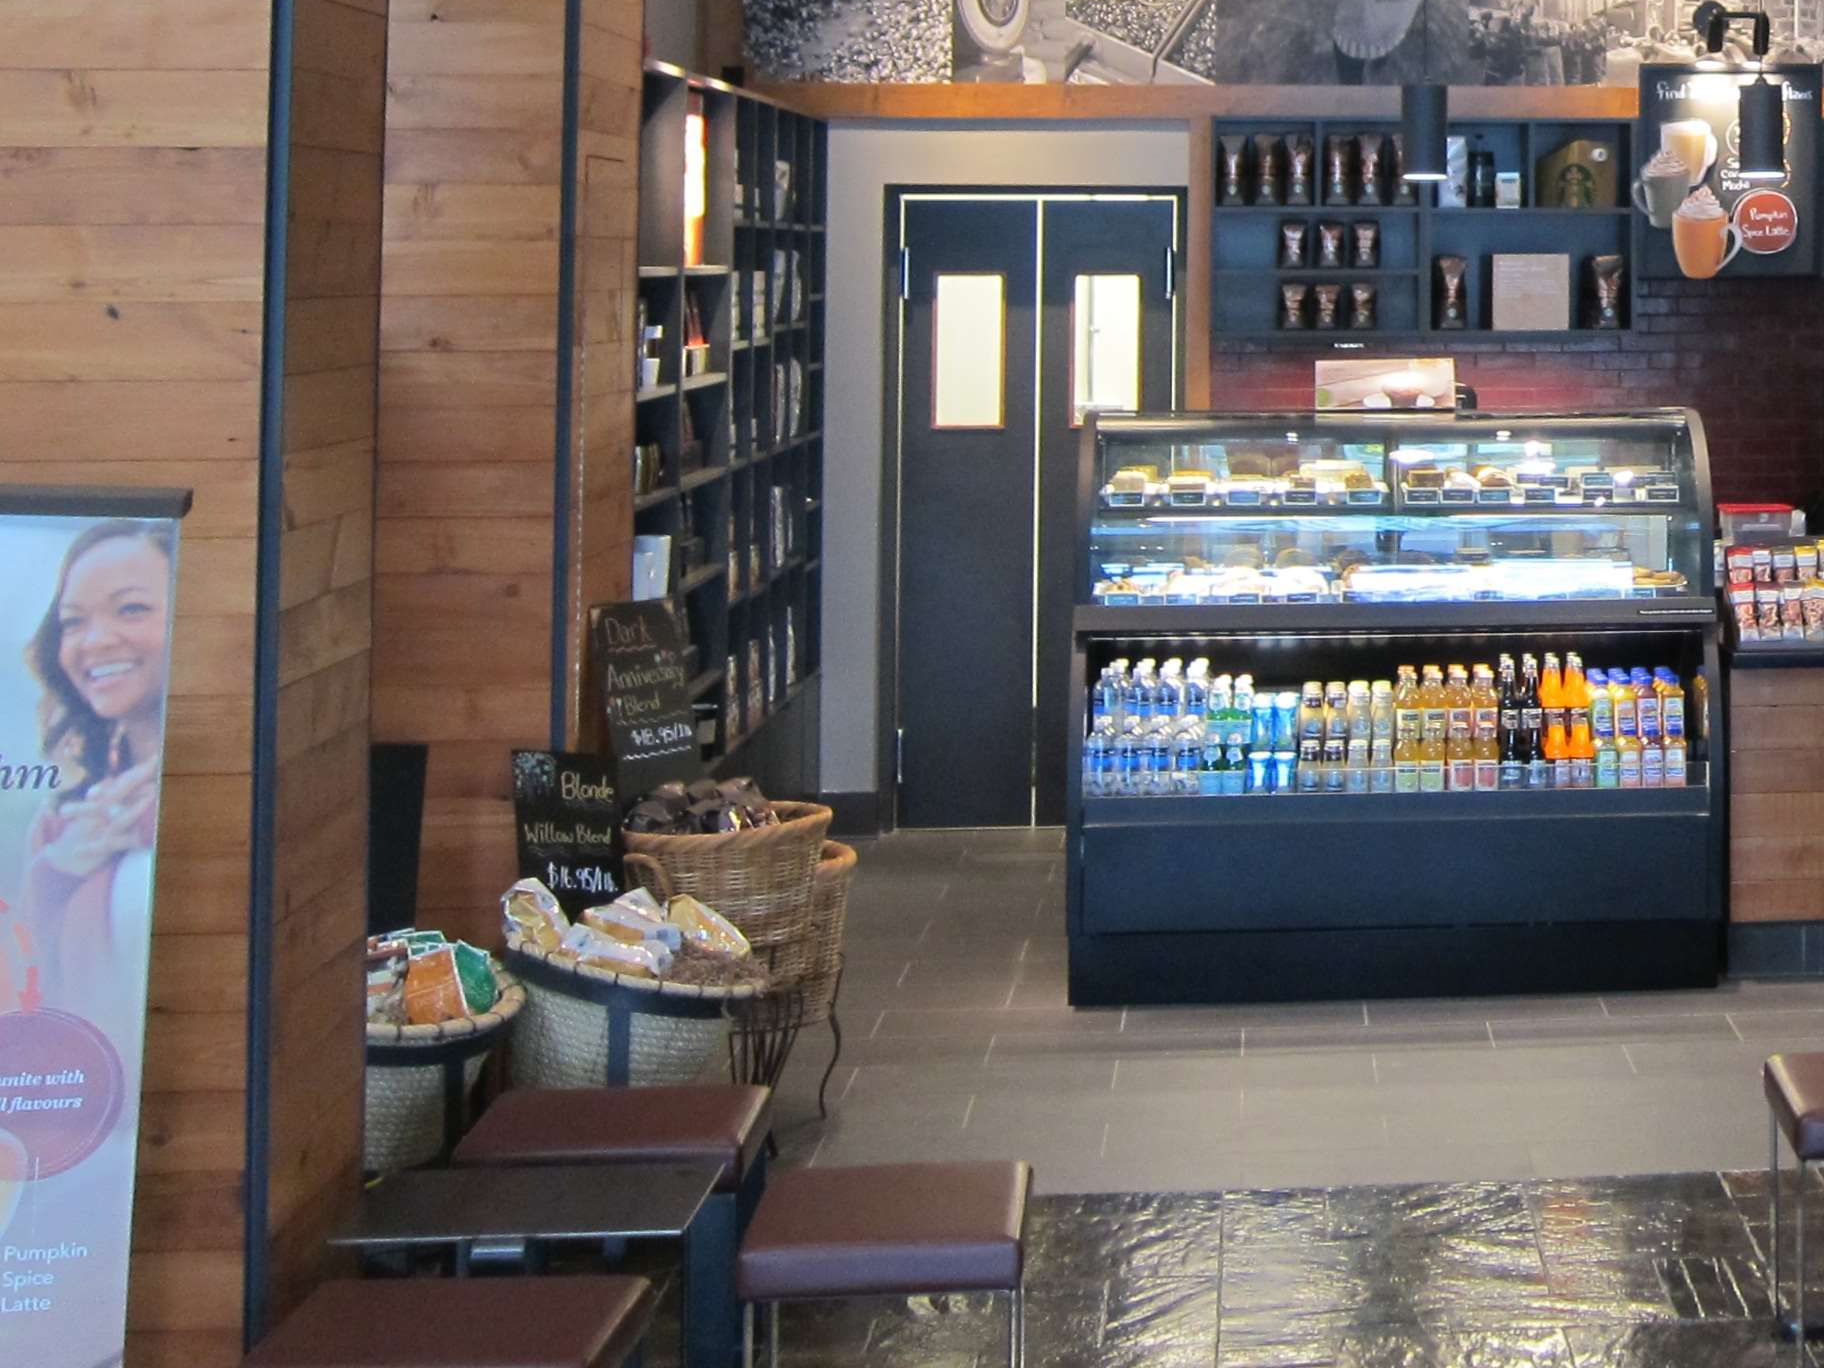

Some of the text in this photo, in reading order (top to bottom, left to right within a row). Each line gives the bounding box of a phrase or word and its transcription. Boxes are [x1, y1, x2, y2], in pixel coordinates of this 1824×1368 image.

[604, 615, 652, 646] Dark
[560, 771, 615, 803] Blonde
[524, 822, 612, 845] Willow Blend
[45, 1069, 85, 1085] with
[7, 1096, 83, 1114] flavours
[3, 1241, 88, 1265] Pumpkin
[2, 1270, 55, 1292] Spice
[0, 1296, 52, 1313] Latte
